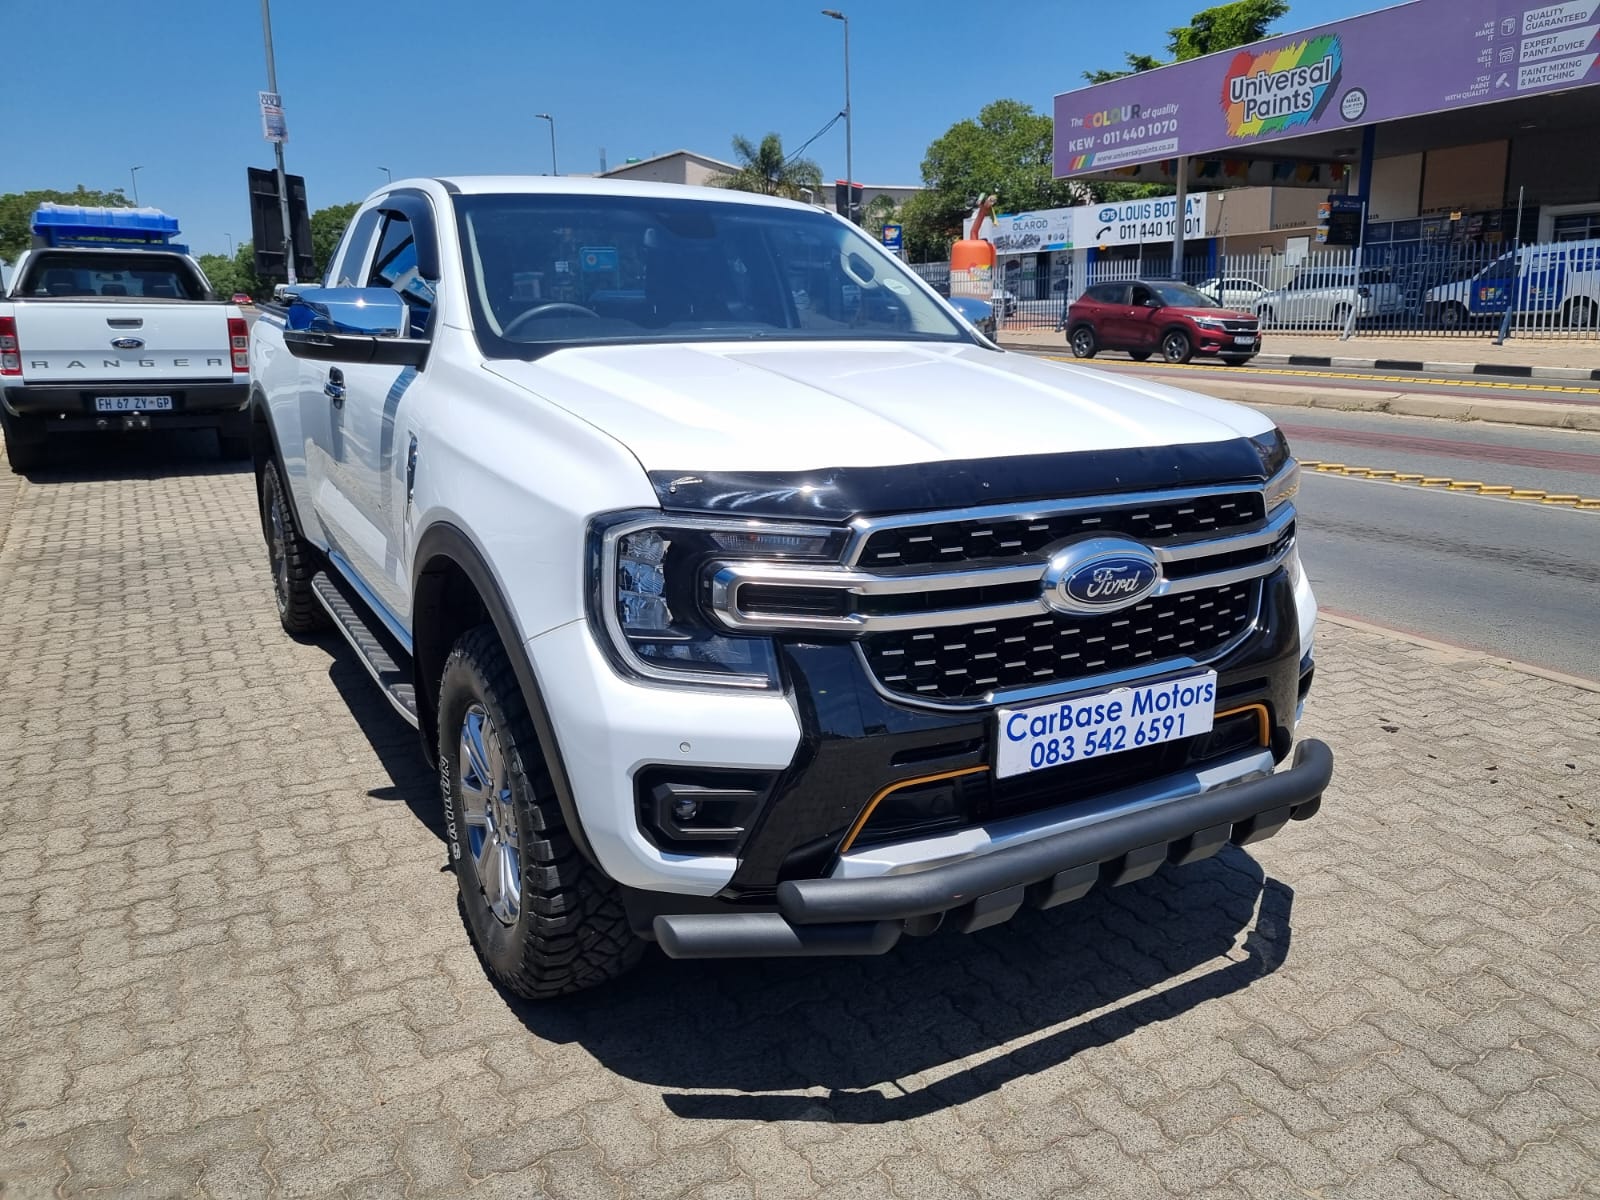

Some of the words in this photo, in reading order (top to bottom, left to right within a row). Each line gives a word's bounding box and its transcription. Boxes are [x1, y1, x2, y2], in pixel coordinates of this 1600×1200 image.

[1525, 11, 1588, 31] GUARANTEED
[1526, 7, 1564, 23] QUALITY
[1475, 28, 1495, 38] MAKE
[1481, 48, 1493, 56] WE
[1522, 47, 1549, 59] PAINT
[1551, 40, 1585, 53] ADVICE
[1523, 36, 1558, 50] EXPERT
[1521, 66, 1547, 78] PAINT
[1549, 60, 1582, 72] MIXING
[1528, 71, 1576, 85] MATCHING
[1231, 58, 1331, 101] Universal
[1470, 82, 1490, 91] PAINT
[1477, 75, 1490, 83] YOU
[1462, 88, 1489, 99] QUALITY
[1246, 90, 1312, 120] Paints
[1071, 118, 1083, 127] The
[1083, 104, 1140, 129] COLOUR
[1142, 111, 1151, 119] of
[1151, 104, 1179, 118] quality
[1069, 136, 1095, 152] KEW
[1103, 131, 1120, 145] 011
[1122, 126, 1145, 141] 440
[1148, 119, 1178, 136] 1070
[1119, 204, 1151, 221] LOUIS
[1154, 199, 1193, 217] BOTA
[1120, 224, 1136, 239] 011
[1141, 222, 1162, 237] 440
[31, 358, 222, 369] RANGER
[98, 399, 112, 409] FH
[117, 398, 128, 409] 67
[134, 398, 147, 409] ZY
[156, 398, 169, 408] GP
[1086, 566, 1140, 598] Ford
[1006, 700, 1122, 742] CarBase
[1131, 683, 1213, 717] Motors
[1030, 735, 1075, 768] 083
[1083, 725, 1126, 756] 542
[1134, 712, 1185, 746] 6591
[440, 755, 461, 860] SAILUN
